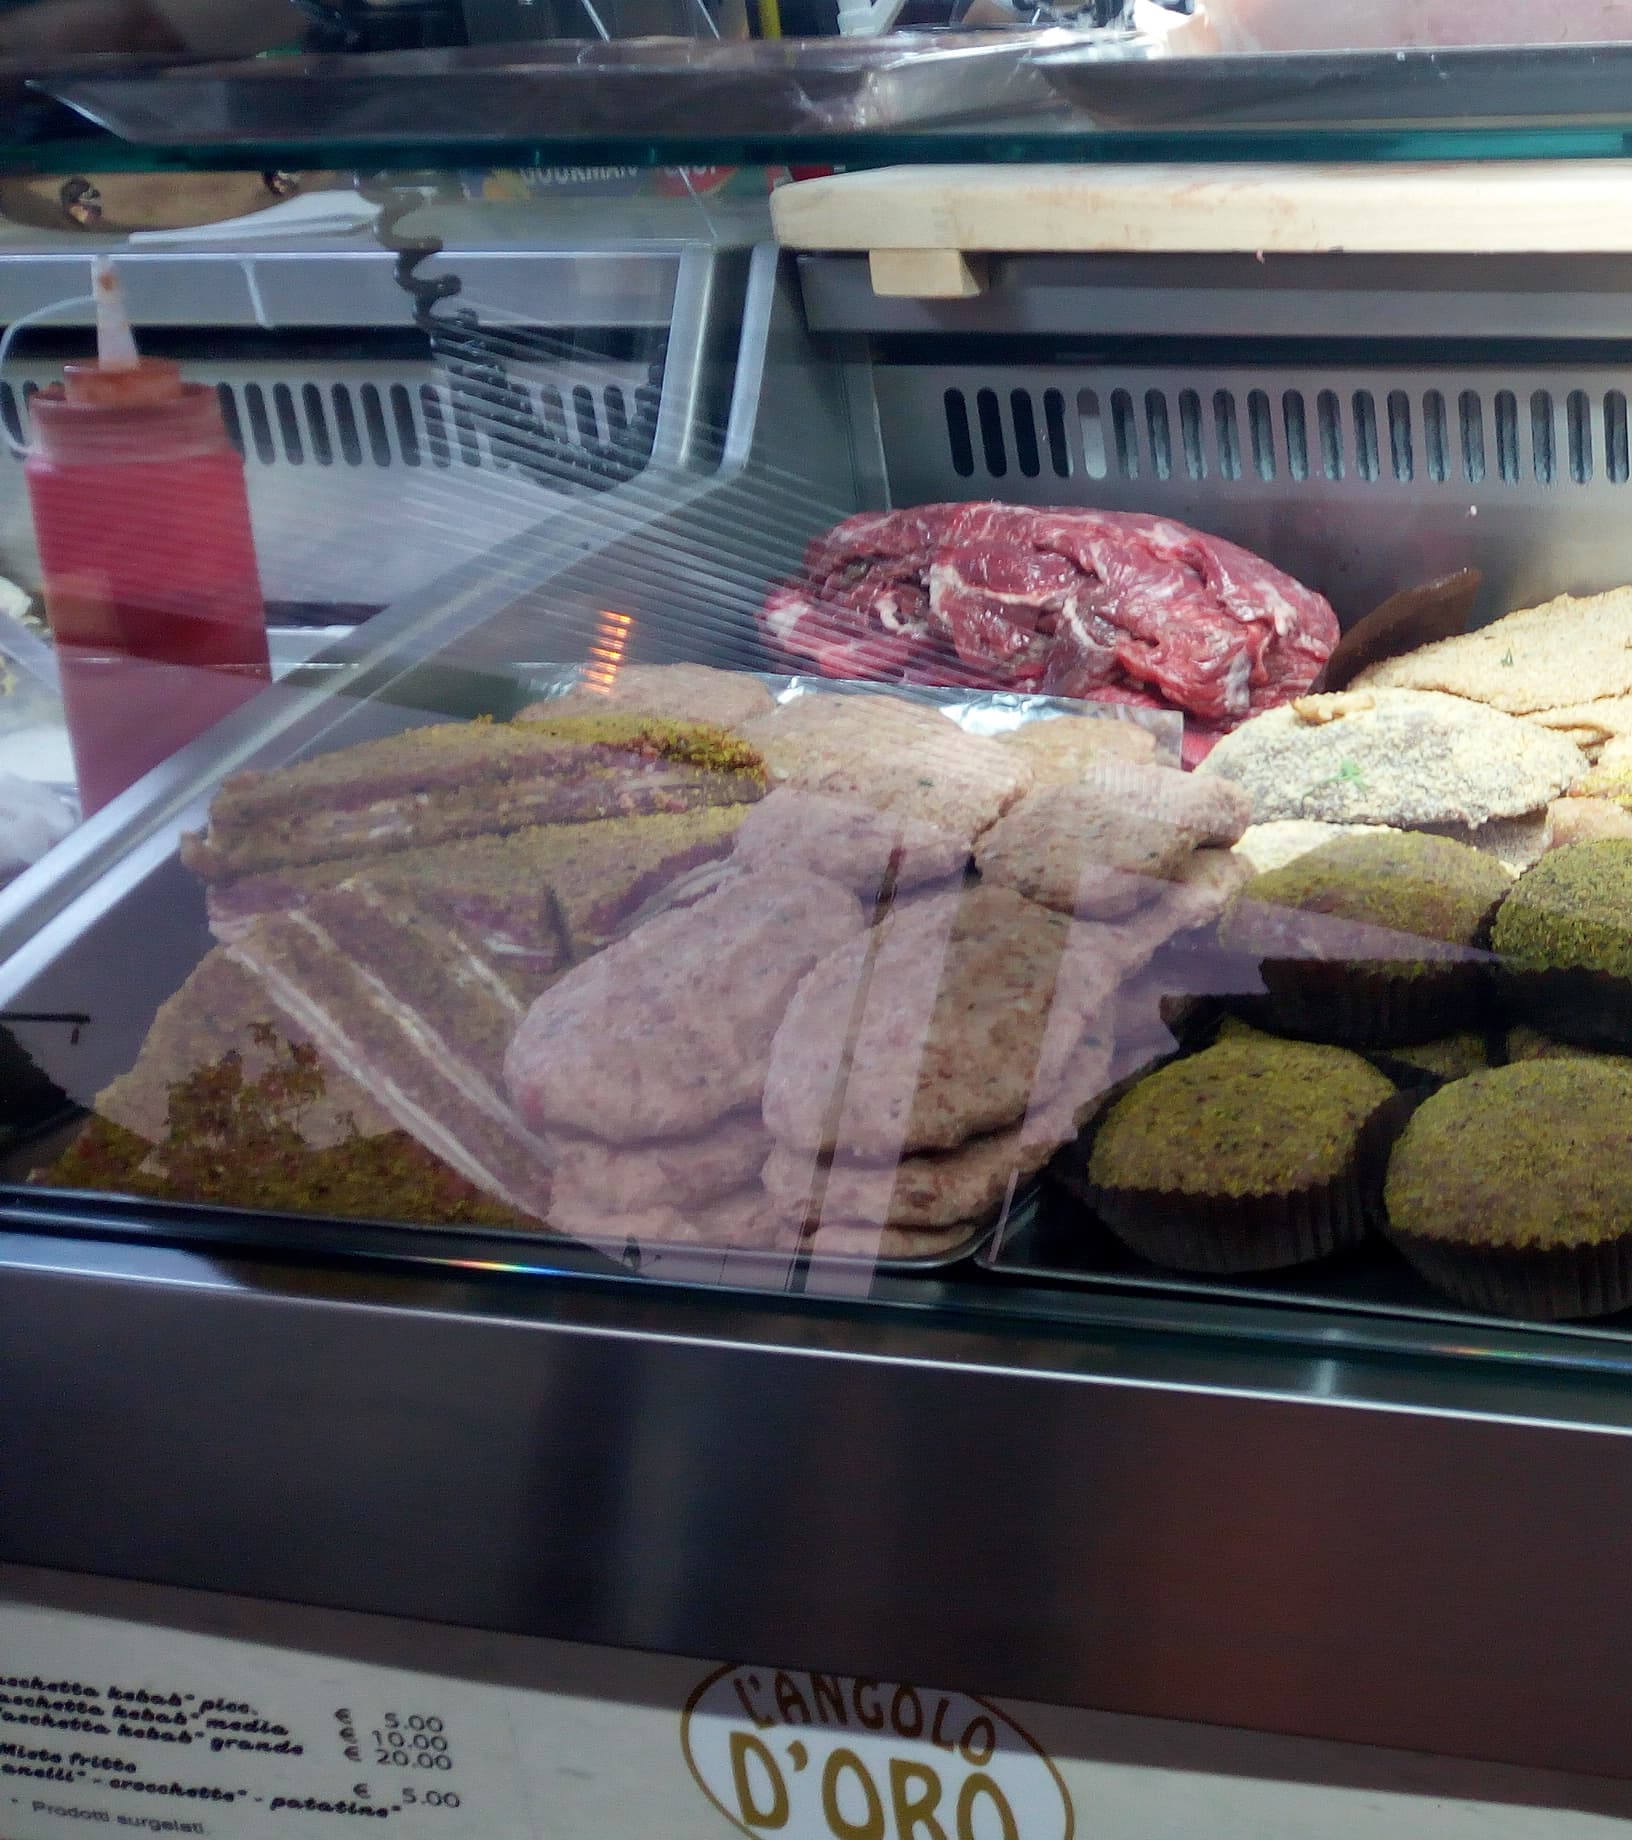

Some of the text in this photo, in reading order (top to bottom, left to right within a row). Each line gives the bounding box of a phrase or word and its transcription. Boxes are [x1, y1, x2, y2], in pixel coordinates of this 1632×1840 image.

[206, 1718, 289, 1736] media
[384, 1712, 444, 1732] 5.00
[733, 1670, 996, 1766] L'ANGOLO
[0, 1707, 111, 1734] aschetta
[210, 1736, 304, 1756] grande
[371, 1730, 448, 1751] 10.00
[375, 1749, 452, 1770] 20.00
[729, 1731, 1020, 1840] D'ORO
[402, 1787, 461, 1809] 5.00
